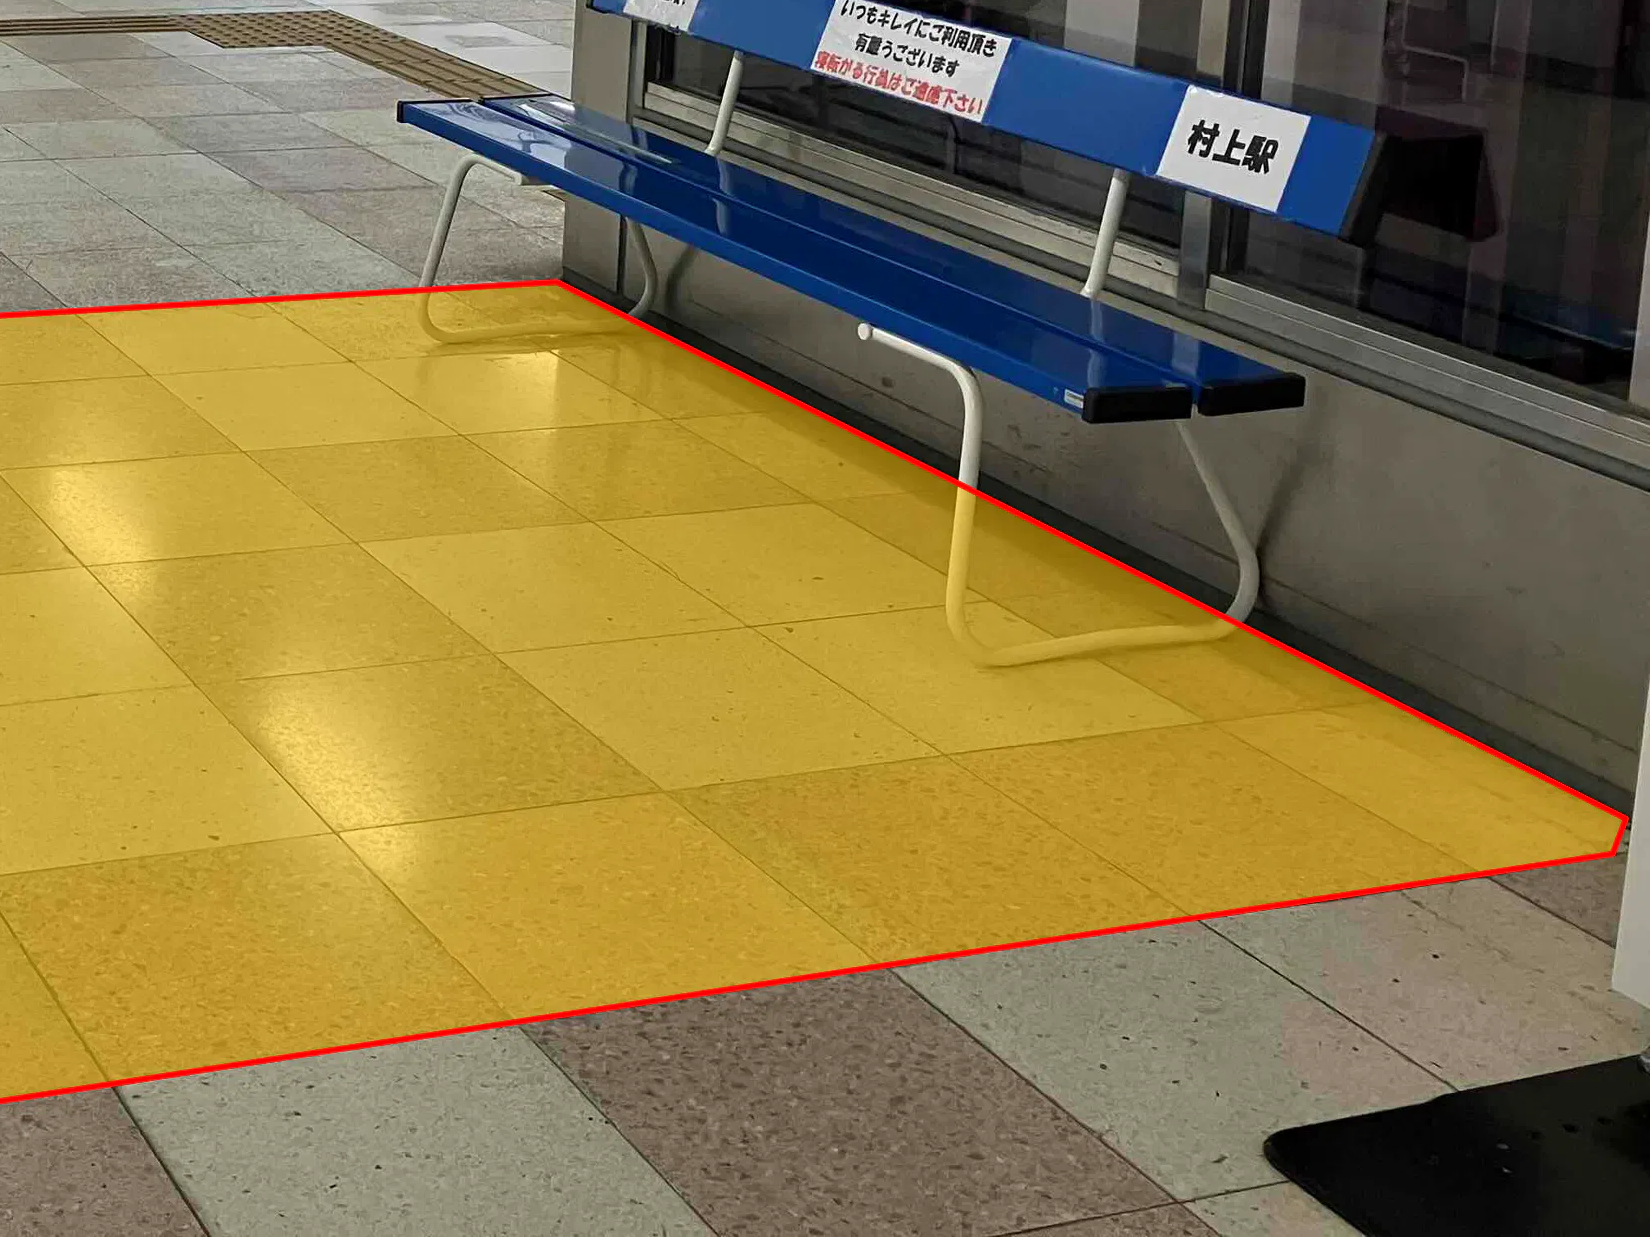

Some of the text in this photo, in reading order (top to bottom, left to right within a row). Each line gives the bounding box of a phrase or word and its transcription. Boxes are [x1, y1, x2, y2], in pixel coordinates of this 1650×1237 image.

[814, 49, 984, 116] 寝転がる行為はご遠慮下さい
[854, 32, 960, 78] 有難うございます
[1187, 119, 1279, 175] 村上駅
